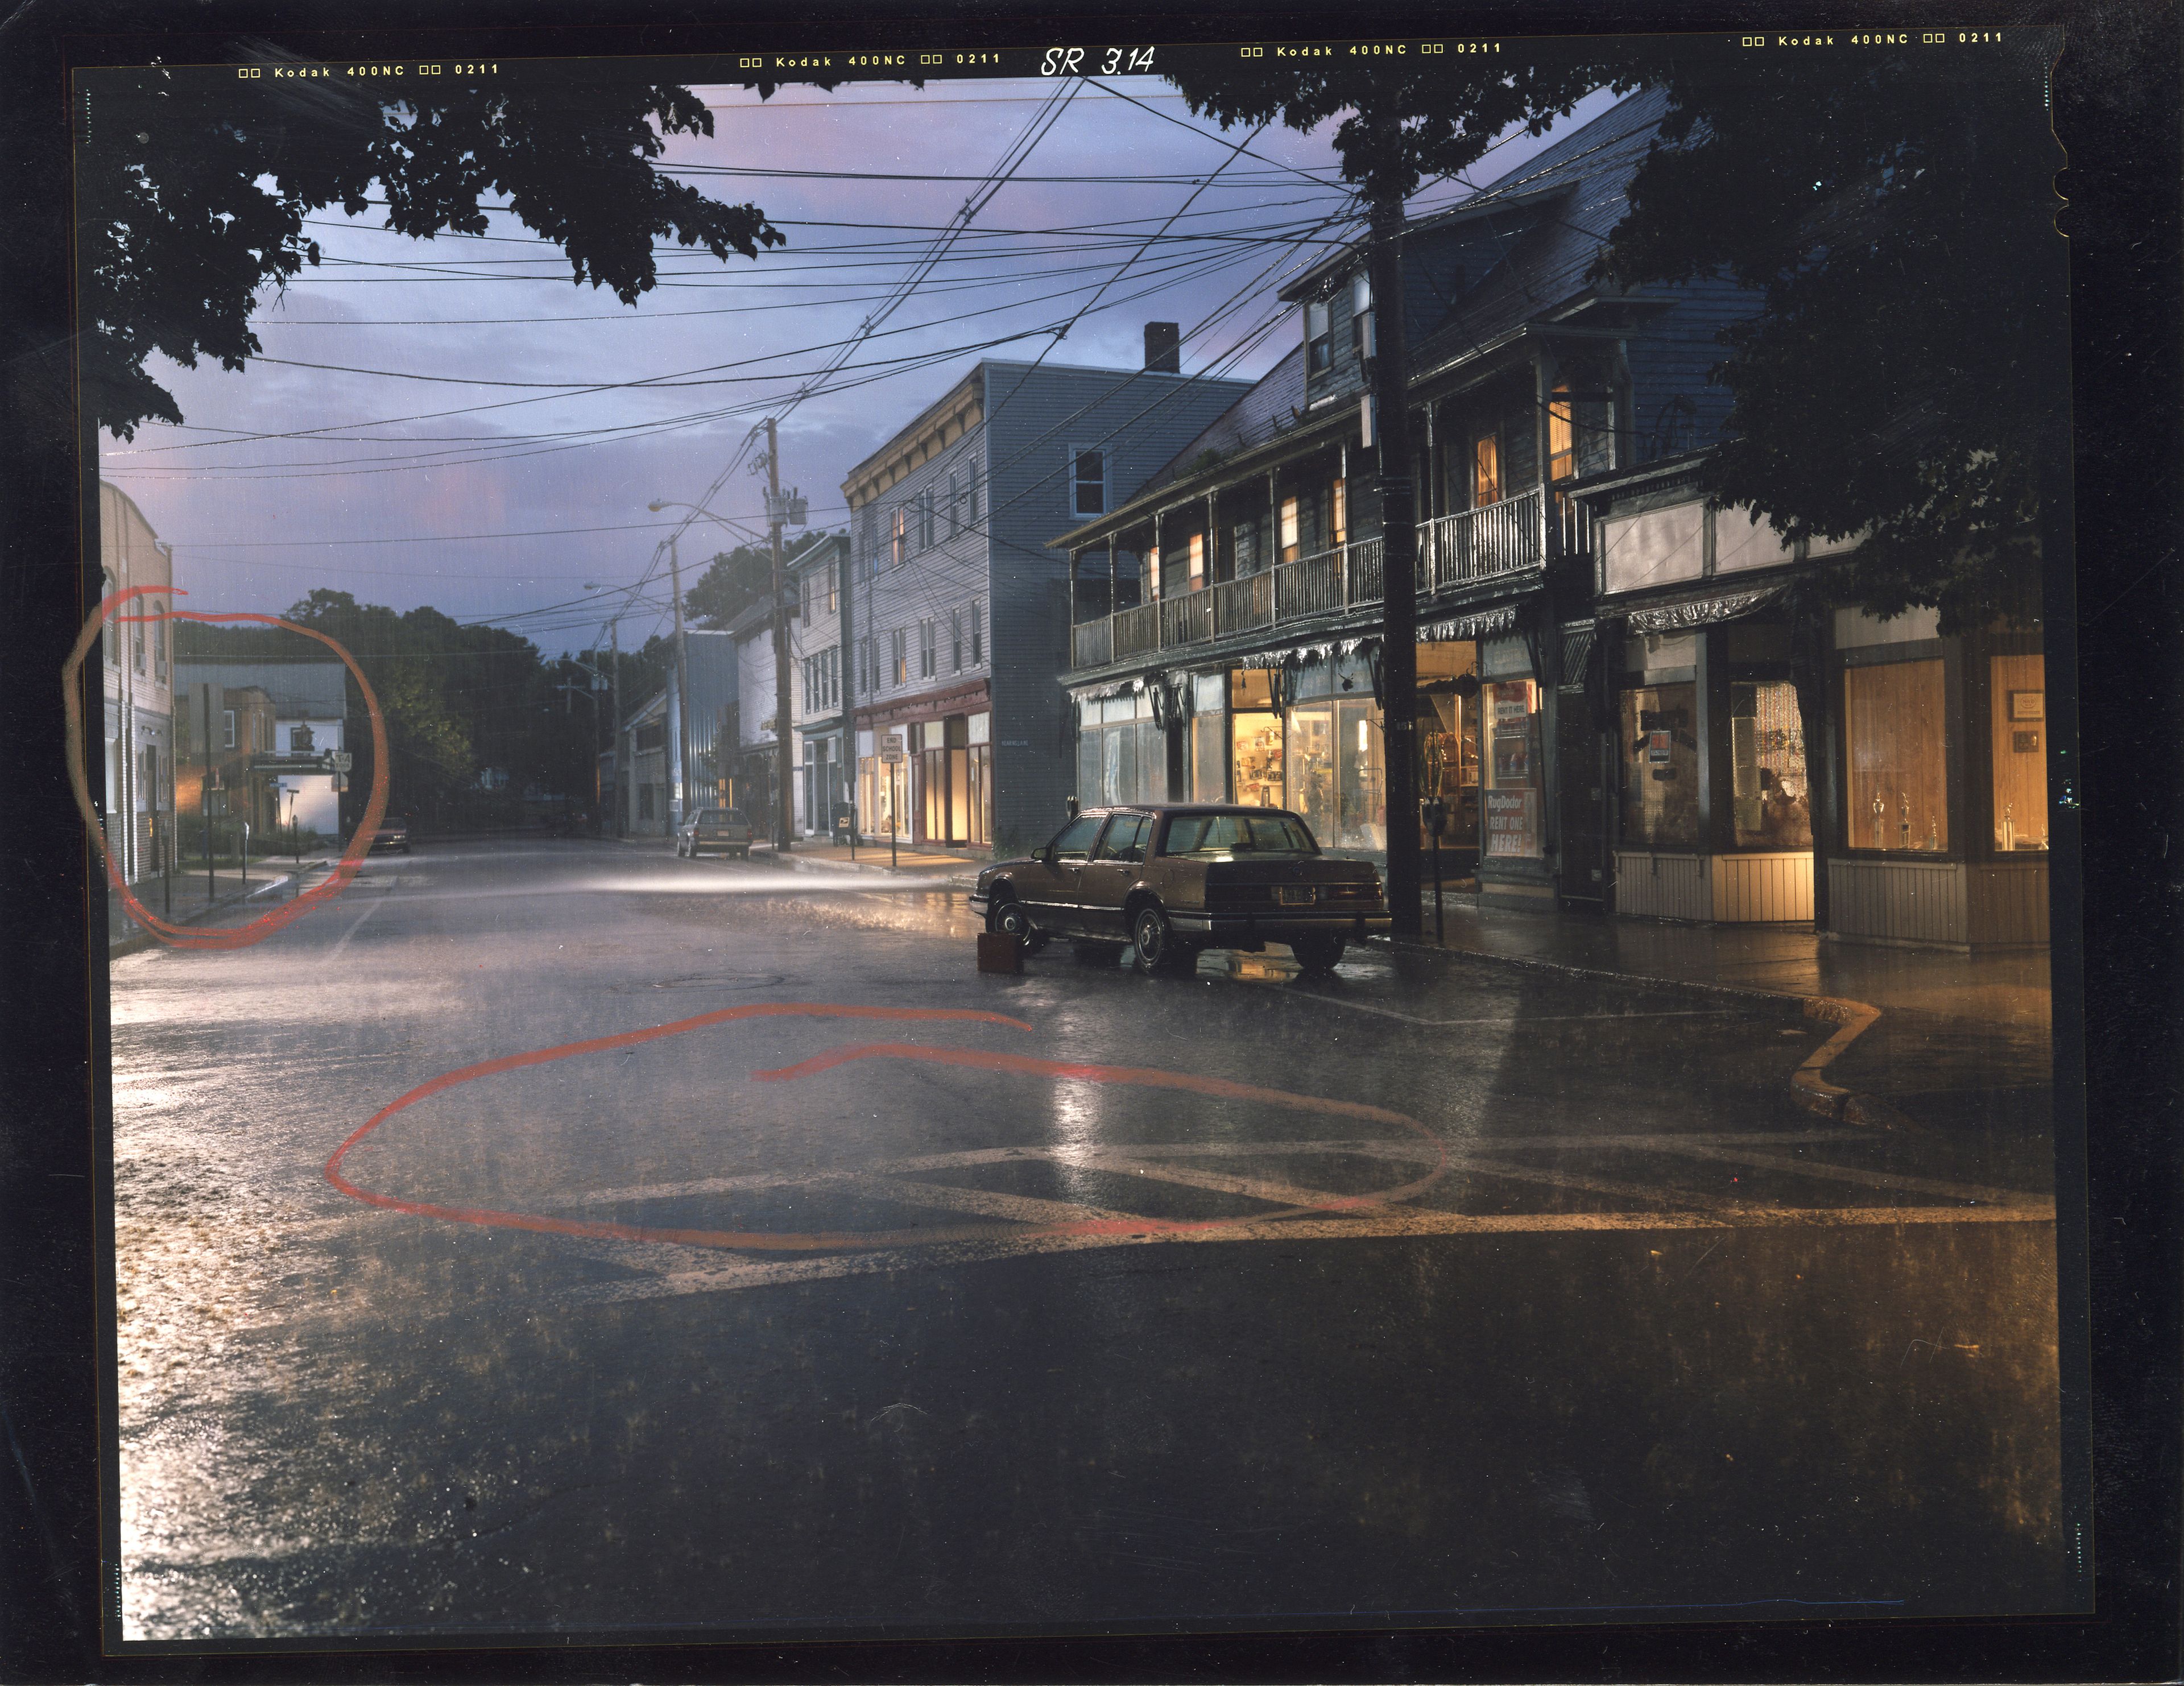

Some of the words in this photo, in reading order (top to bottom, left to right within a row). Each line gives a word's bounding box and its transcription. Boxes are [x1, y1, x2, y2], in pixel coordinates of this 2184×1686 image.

[1778, 35, 1833, 46] Kodak
[1851, 34, 1907, 44] 400NC
[1959, 32, 2001, 43] 0211
[1277, 46, 1331, 56] Kodak
[1350, 44, 1406, 55] 400NC
[1458, 43, 1499, 53] 0211
[776, 56, 830, 67] Kodak
[849, 55, 905, 65] 400NC
[957, 53, 998, 64] 0211
[1041, 47, 1085, 76] SR
[1101, 47, 1156, 76] 3.14
[275, 67, 329, 78] Kodak
[347, 65, 403, 76] 400NC
[455, 64, 497, 75] 0211
[1489, 816, 1508, 830] RENT
[1510, 816, 1523, 830] ONE
[1490, 834, 1522, 853] HERE!
